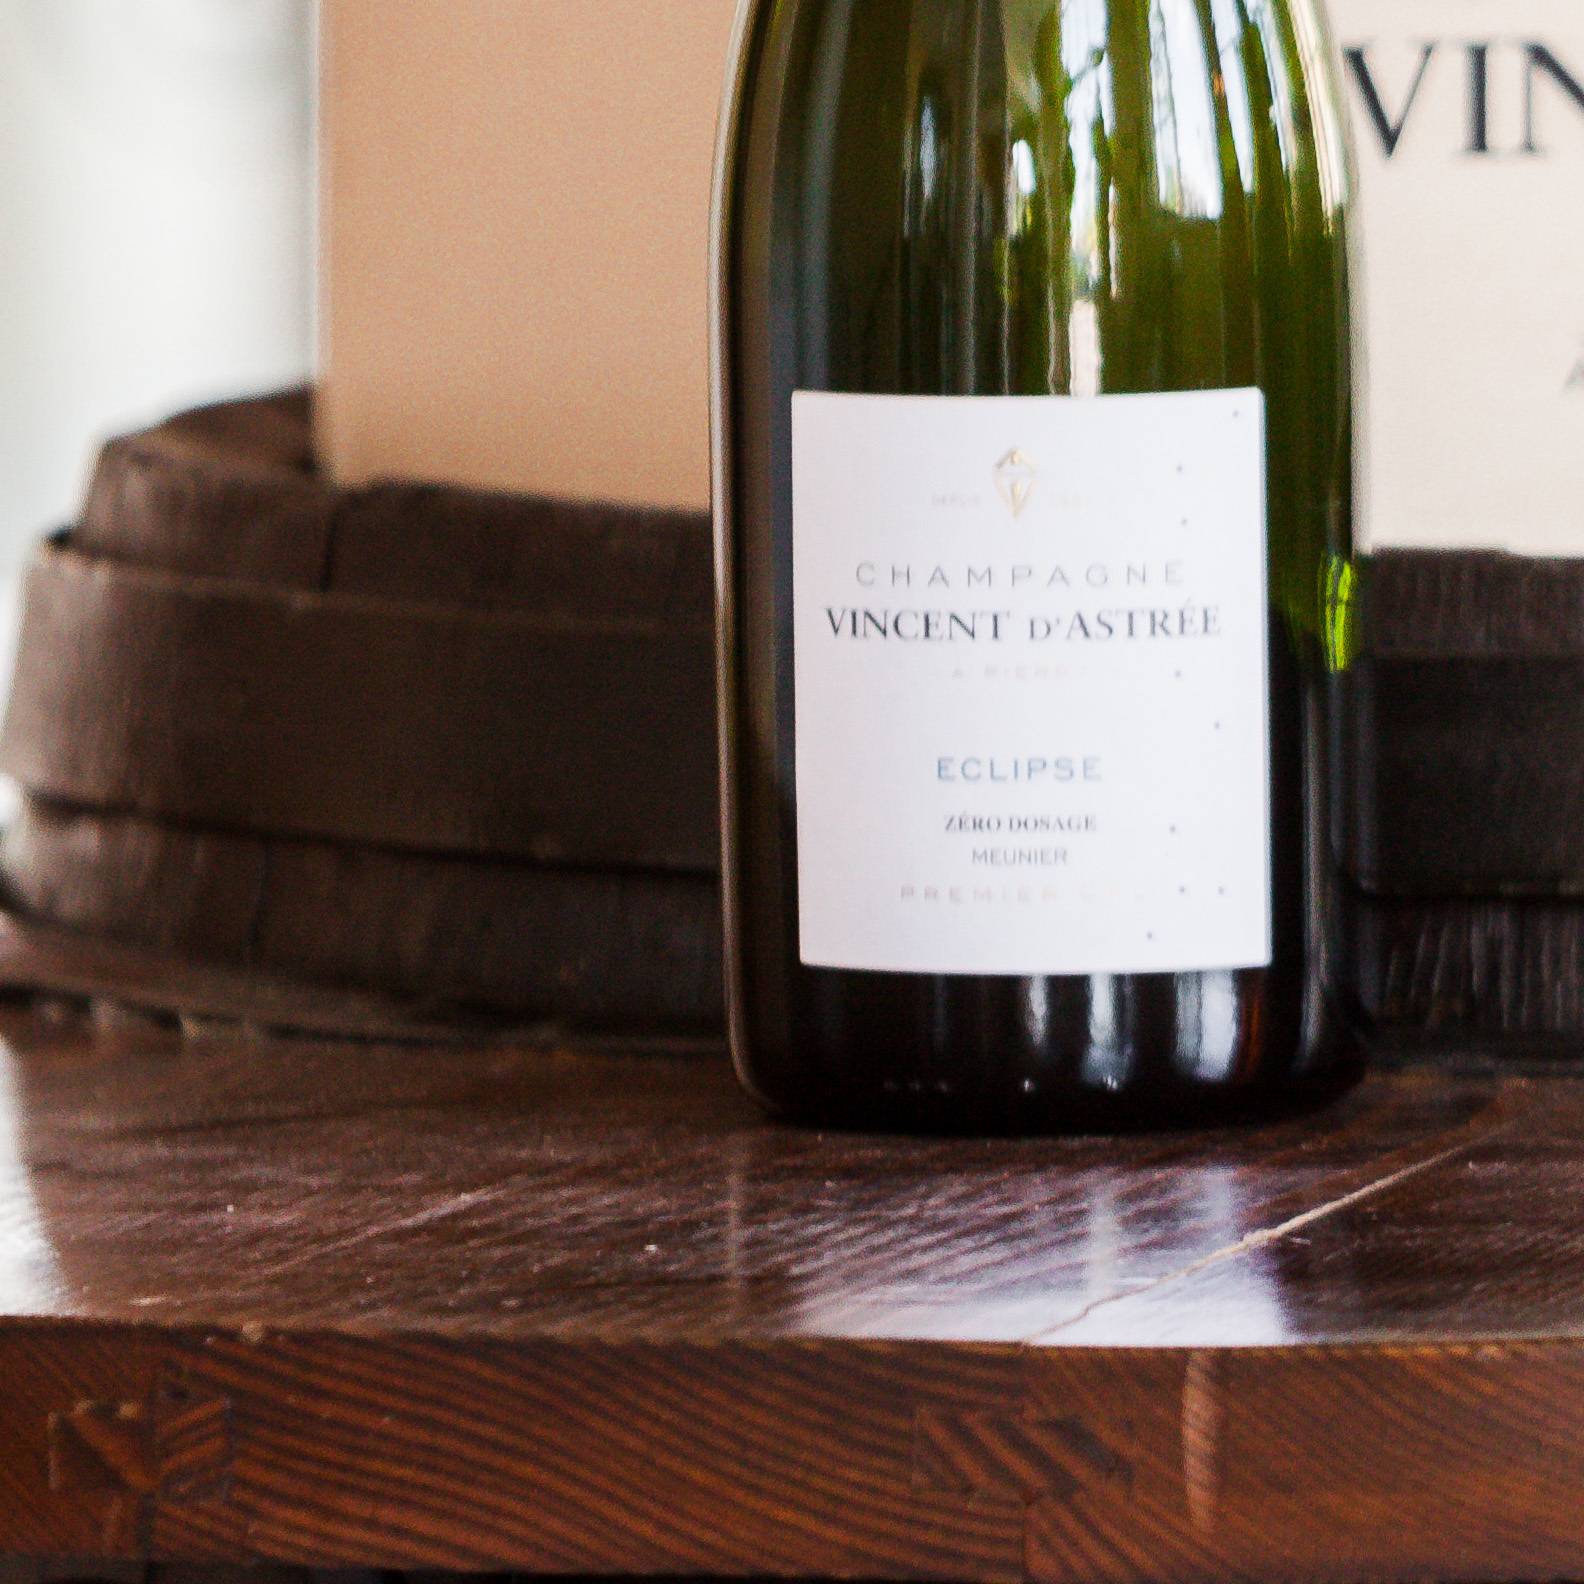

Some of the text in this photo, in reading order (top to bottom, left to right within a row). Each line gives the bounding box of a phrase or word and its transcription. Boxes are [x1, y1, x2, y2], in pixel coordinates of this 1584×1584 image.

[855, 560, 1185, 588] CHAMPAGNE
[825, 598, 1222, 642] VINCENT D'ASTRÉE
[936, 757, 1102, 783] ECLIPSE
[944, 811, 1098, 833] ZÉRO DOSAGE
[971, 847, 1068, 867] MEUNIER
